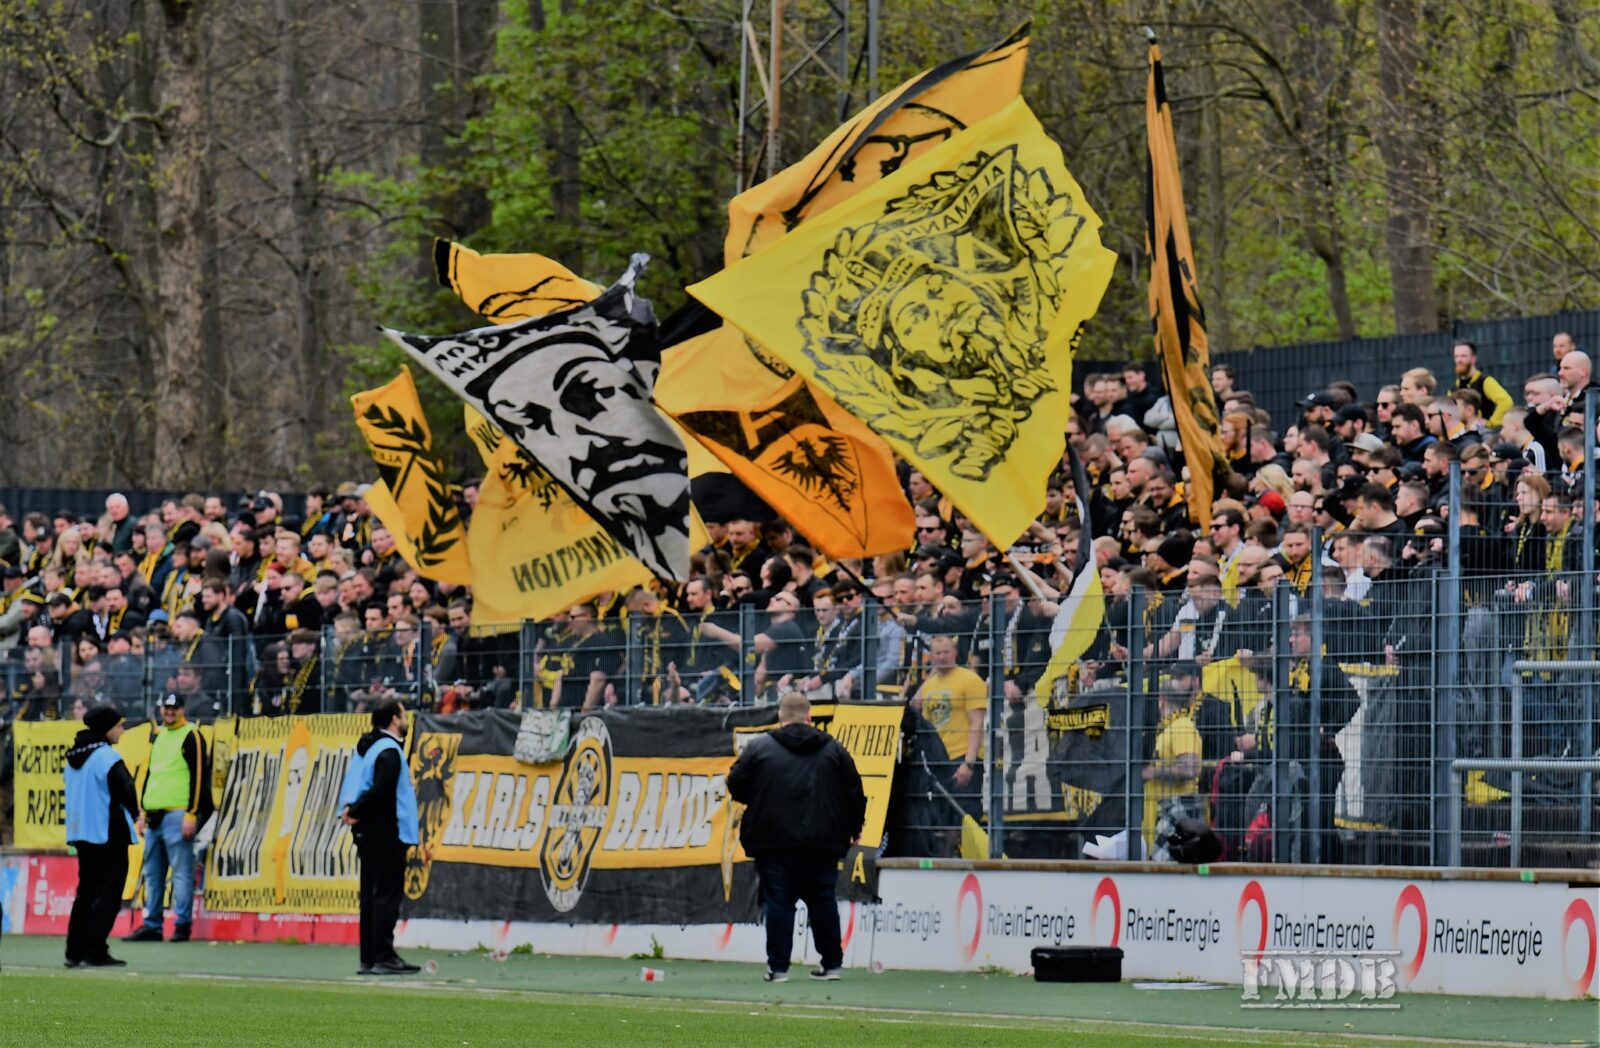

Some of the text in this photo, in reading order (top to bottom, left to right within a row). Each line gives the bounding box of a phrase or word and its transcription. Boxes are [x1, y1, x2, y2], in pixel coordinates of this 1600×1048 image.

[441, 771, 551, 850] KARLS
[602, 772, 727, 850] BANDE
[859, 903, 942, 941] RheinEnergie
[987, 905, 1075, 946] RheinEnergie
[1126, 909, 1221, 951] RheinEnergie
[1273, 914, 1375, 957] RheinEnergie
[1434, 919, 1543, 965] RheinEnergie
